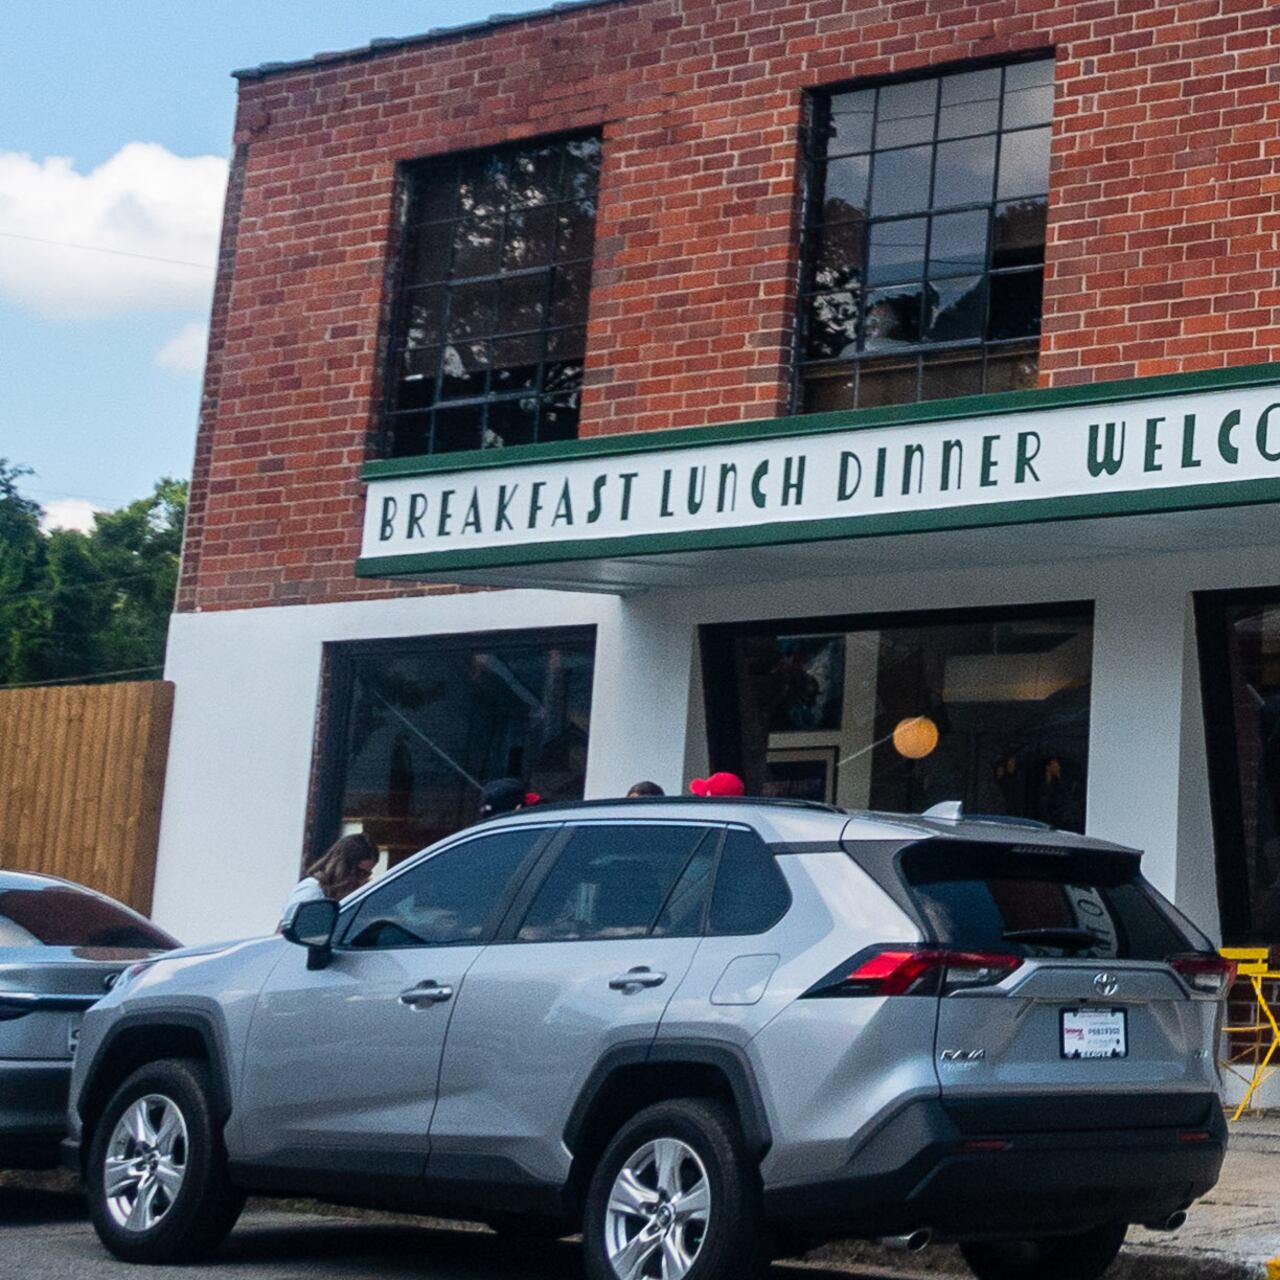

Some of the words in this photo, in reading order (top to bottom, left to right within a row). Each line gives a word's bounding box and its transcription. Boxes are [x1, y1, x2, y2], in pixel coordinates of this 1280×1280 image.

[379, 472, 638, 541] BREAKFAST
[660, 455, 807, 517] LUNCH
[837, 431, 1042, 502] DINNER
